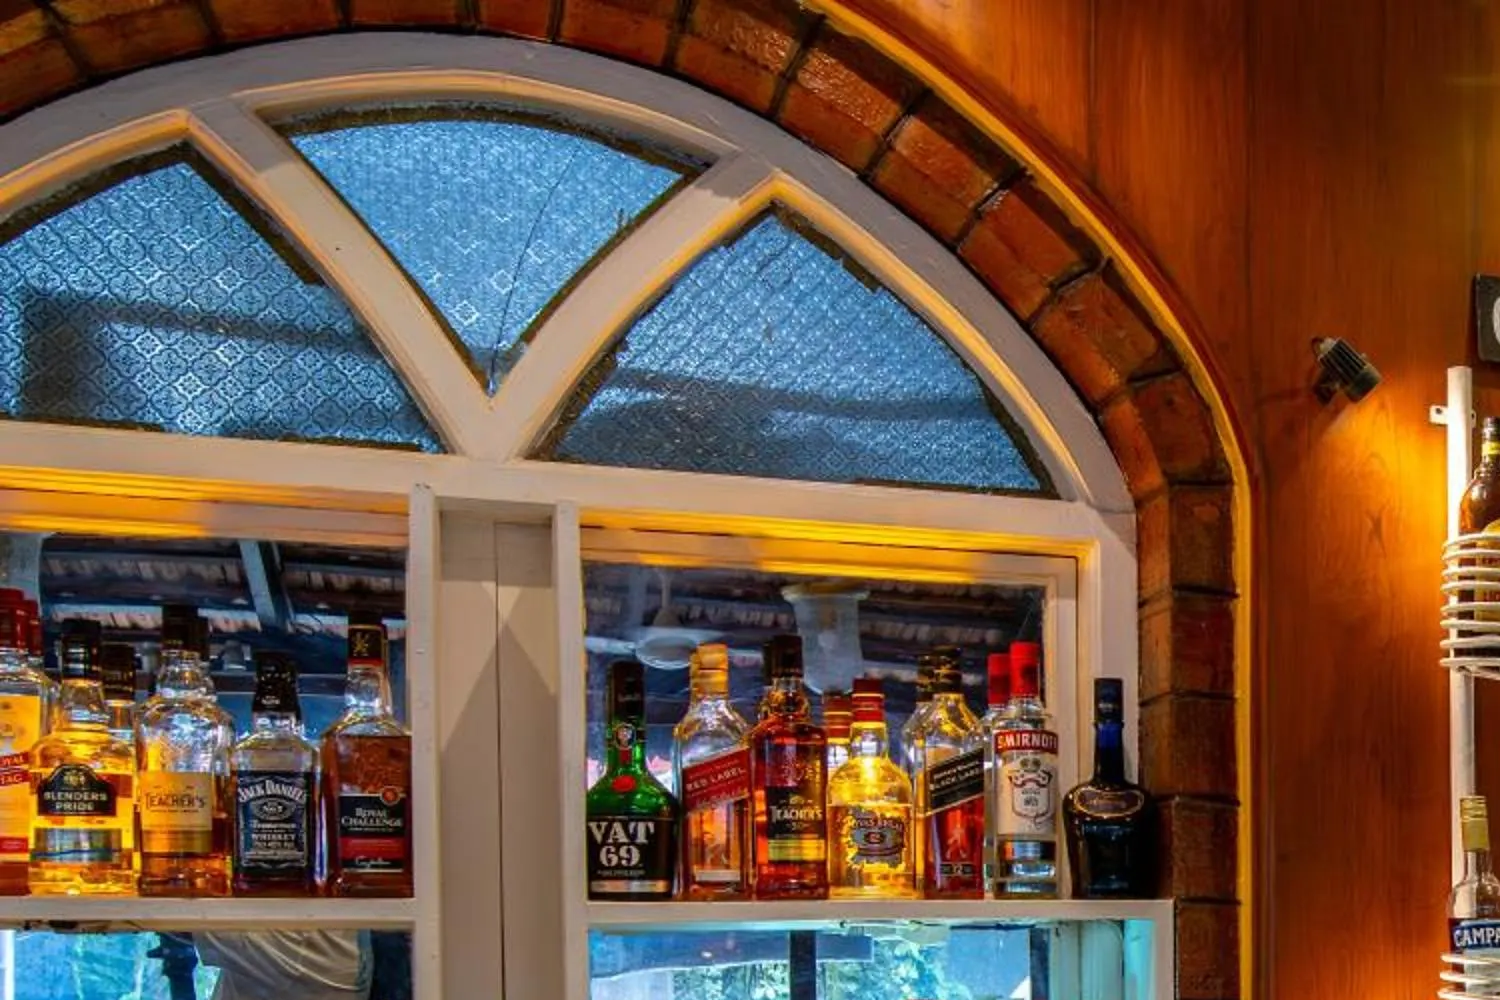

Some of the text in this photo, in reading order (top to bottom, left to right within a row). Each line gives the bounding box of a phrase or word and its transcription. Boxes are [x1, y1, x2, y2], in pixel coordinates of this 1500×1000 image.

[710, 766, 746, 782] LABEL
[238, 783, 264, 802] JACK
[55, 801, 95, 811] PRIDE
[355, 807, 388, 818] ROYAL
[770, 805, 824, 823] TEACHER'S
[586, 820, 656, 844] VAT
[599, 844, 641, 868] 69
